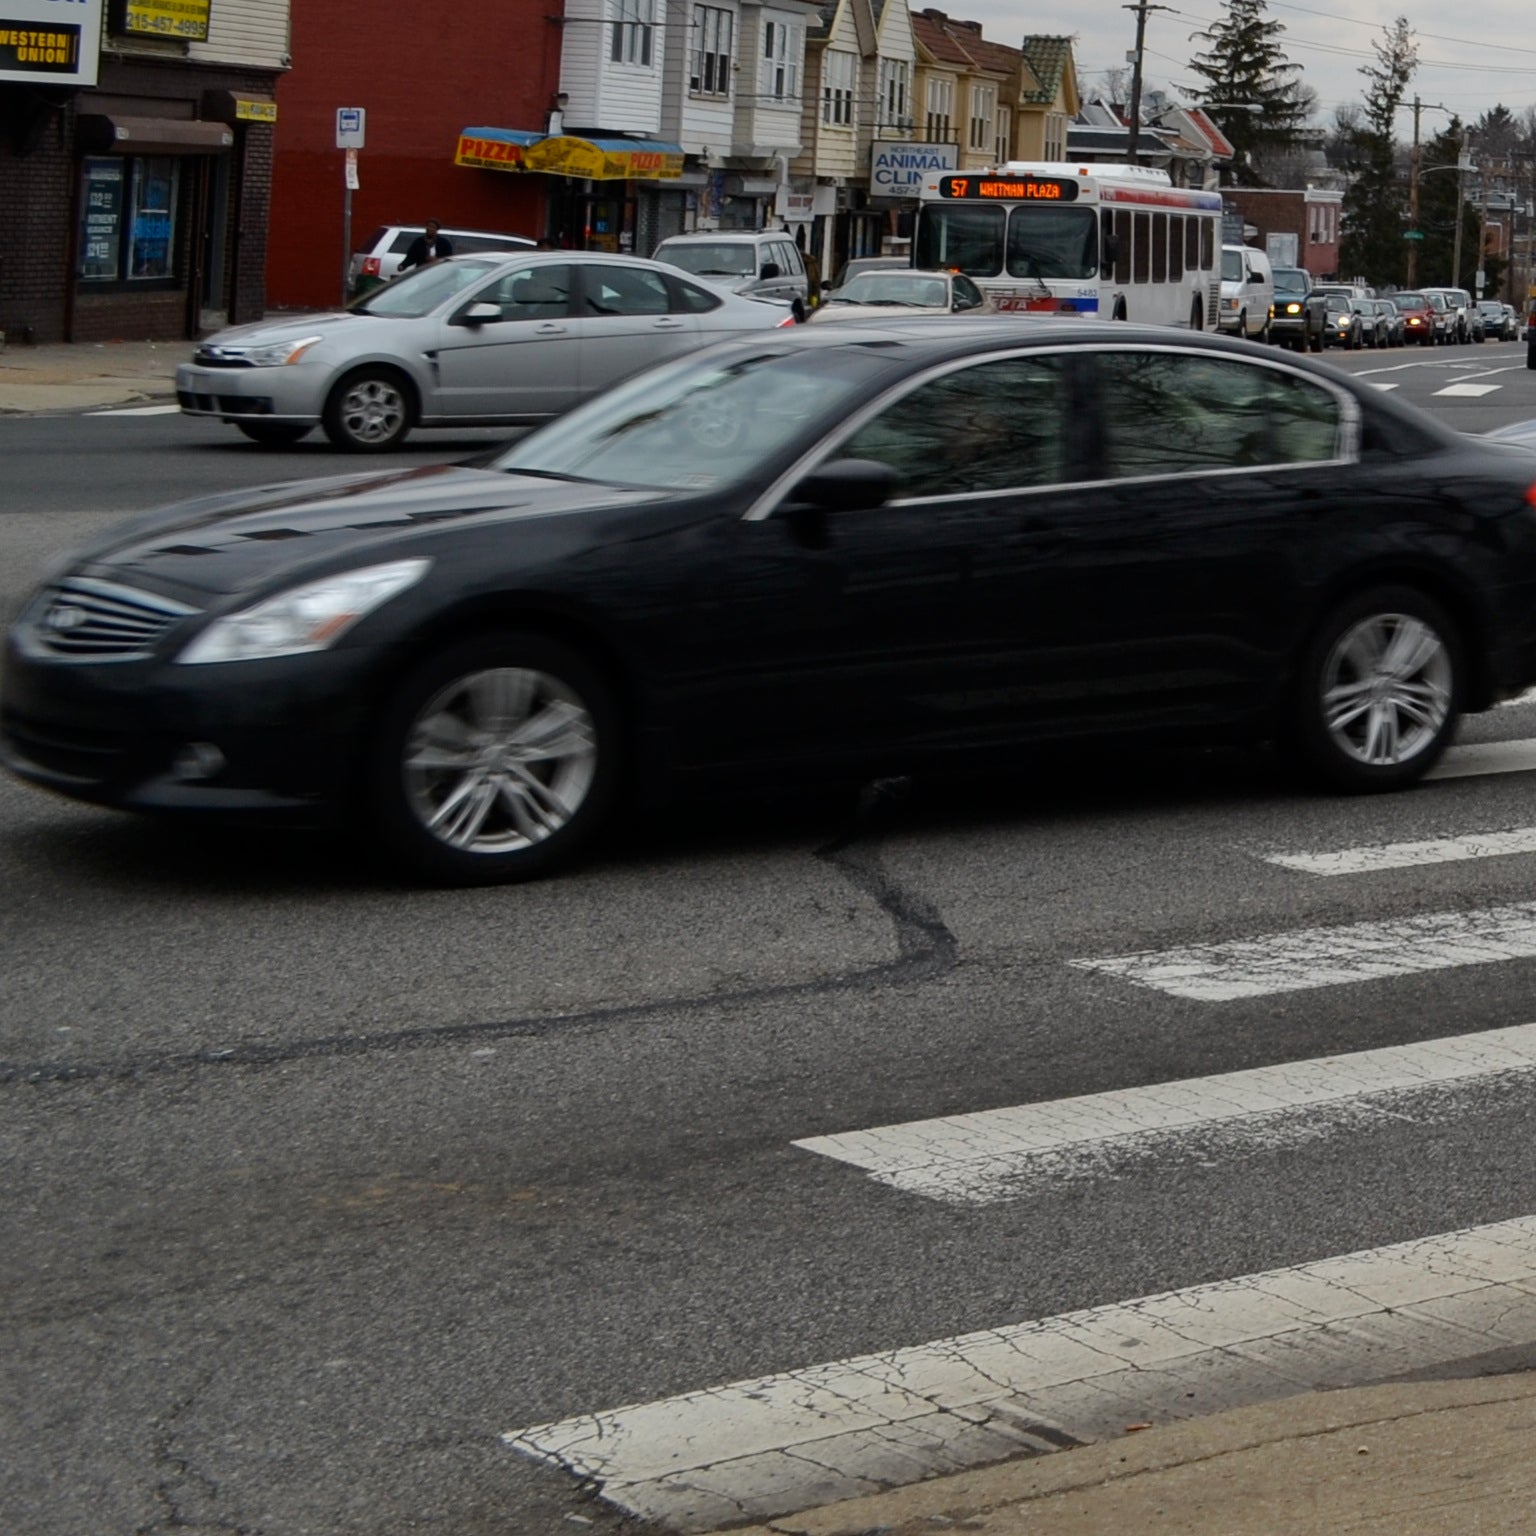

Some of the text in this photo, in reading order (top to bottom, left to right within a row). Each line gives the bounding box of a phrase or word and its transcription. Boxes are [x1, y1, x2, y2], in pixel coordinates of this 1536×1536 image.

[0, 30, 67, 48] WESTERN
[17, 47, 68, 63] UNION
[460, 138, 522, 161] PIZZA
[890, 146, 939, 155] NORTHEAST
[629, 152, 662, 170] PIZZA
[875, 153, 953, 170] ANIMAL
[875, 169, 923, 185] CLIN
[888, 186, 921, 195] 457-7
[951, 179, 1061, 198] 57 WHITMAN PLAZA
